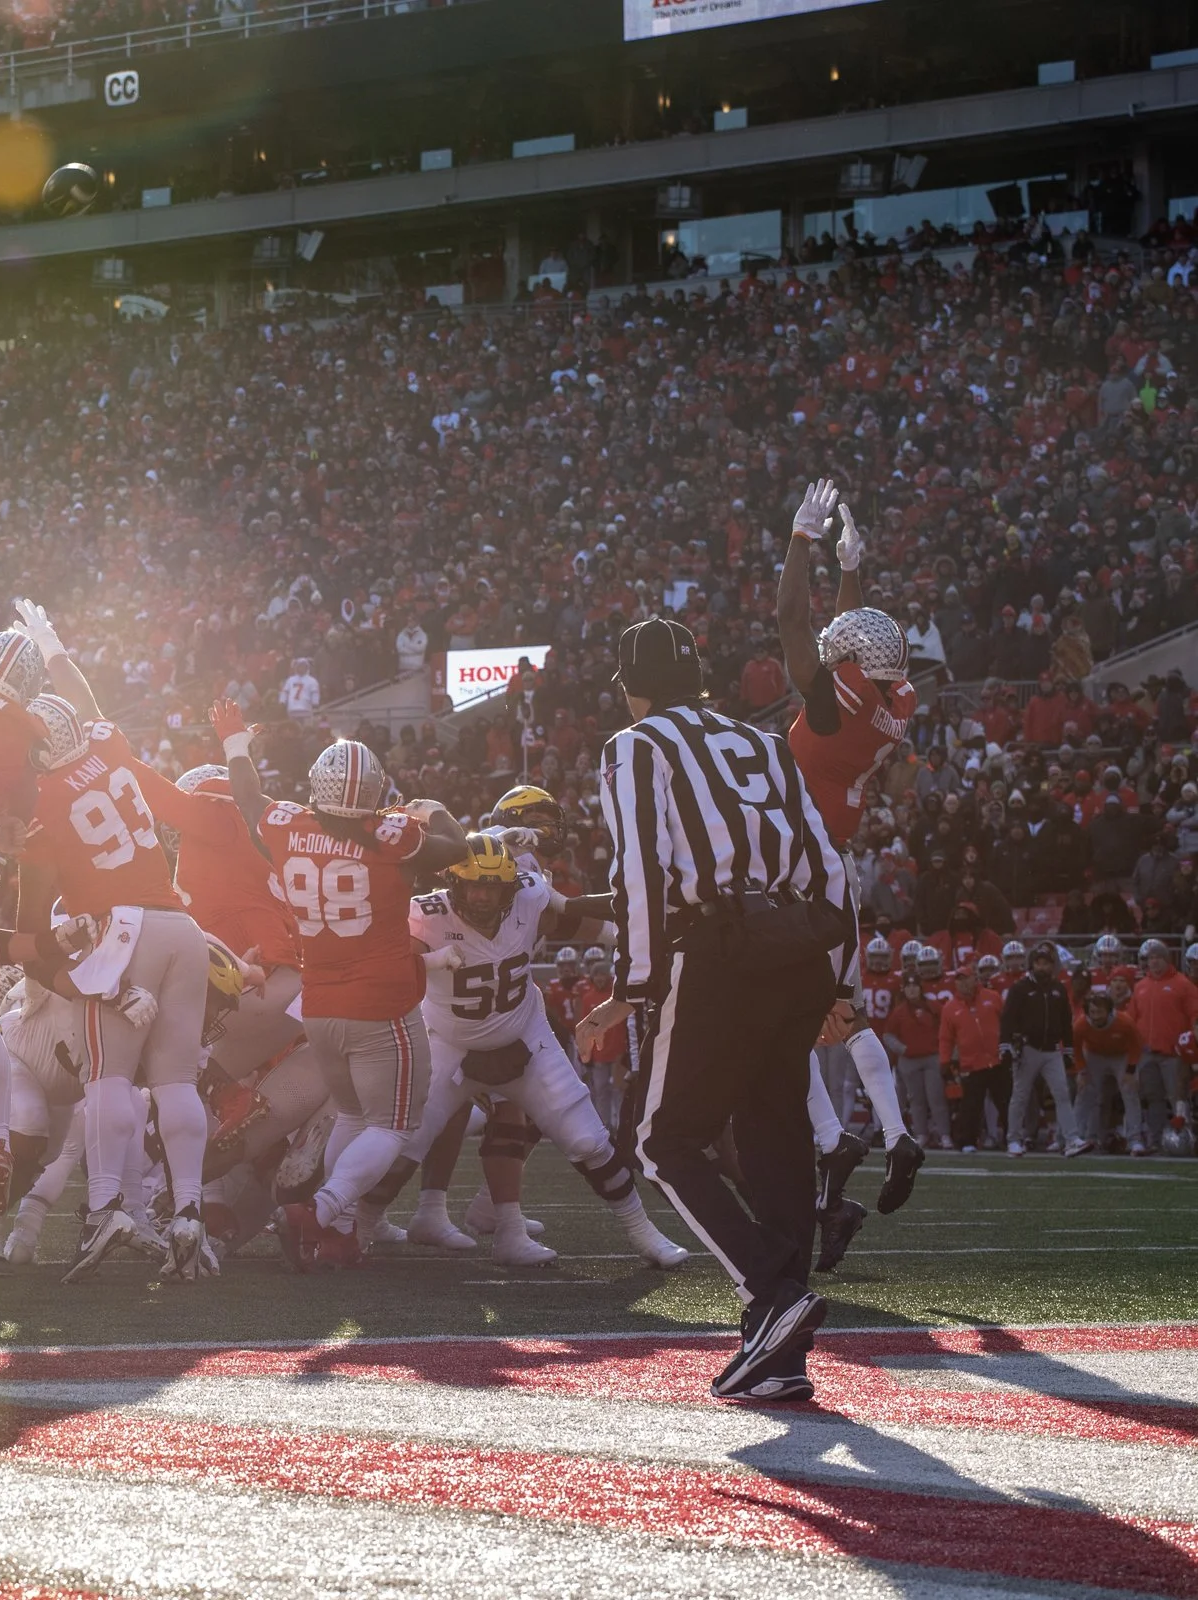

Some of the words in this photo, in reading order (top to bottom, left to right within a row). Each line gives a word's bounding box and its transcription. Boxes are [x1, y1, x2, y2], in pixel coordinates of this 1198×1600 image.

[109, 75, 135, 102] CC
[459, 665, 538, 683] HON
[64, 755, 108, 791] KANU
[704, 732, 770, 802] C
[69, 767, 158, 869] 93
[283, 856, 372, 938] 98
[451, 951, 529, 1020] 56
